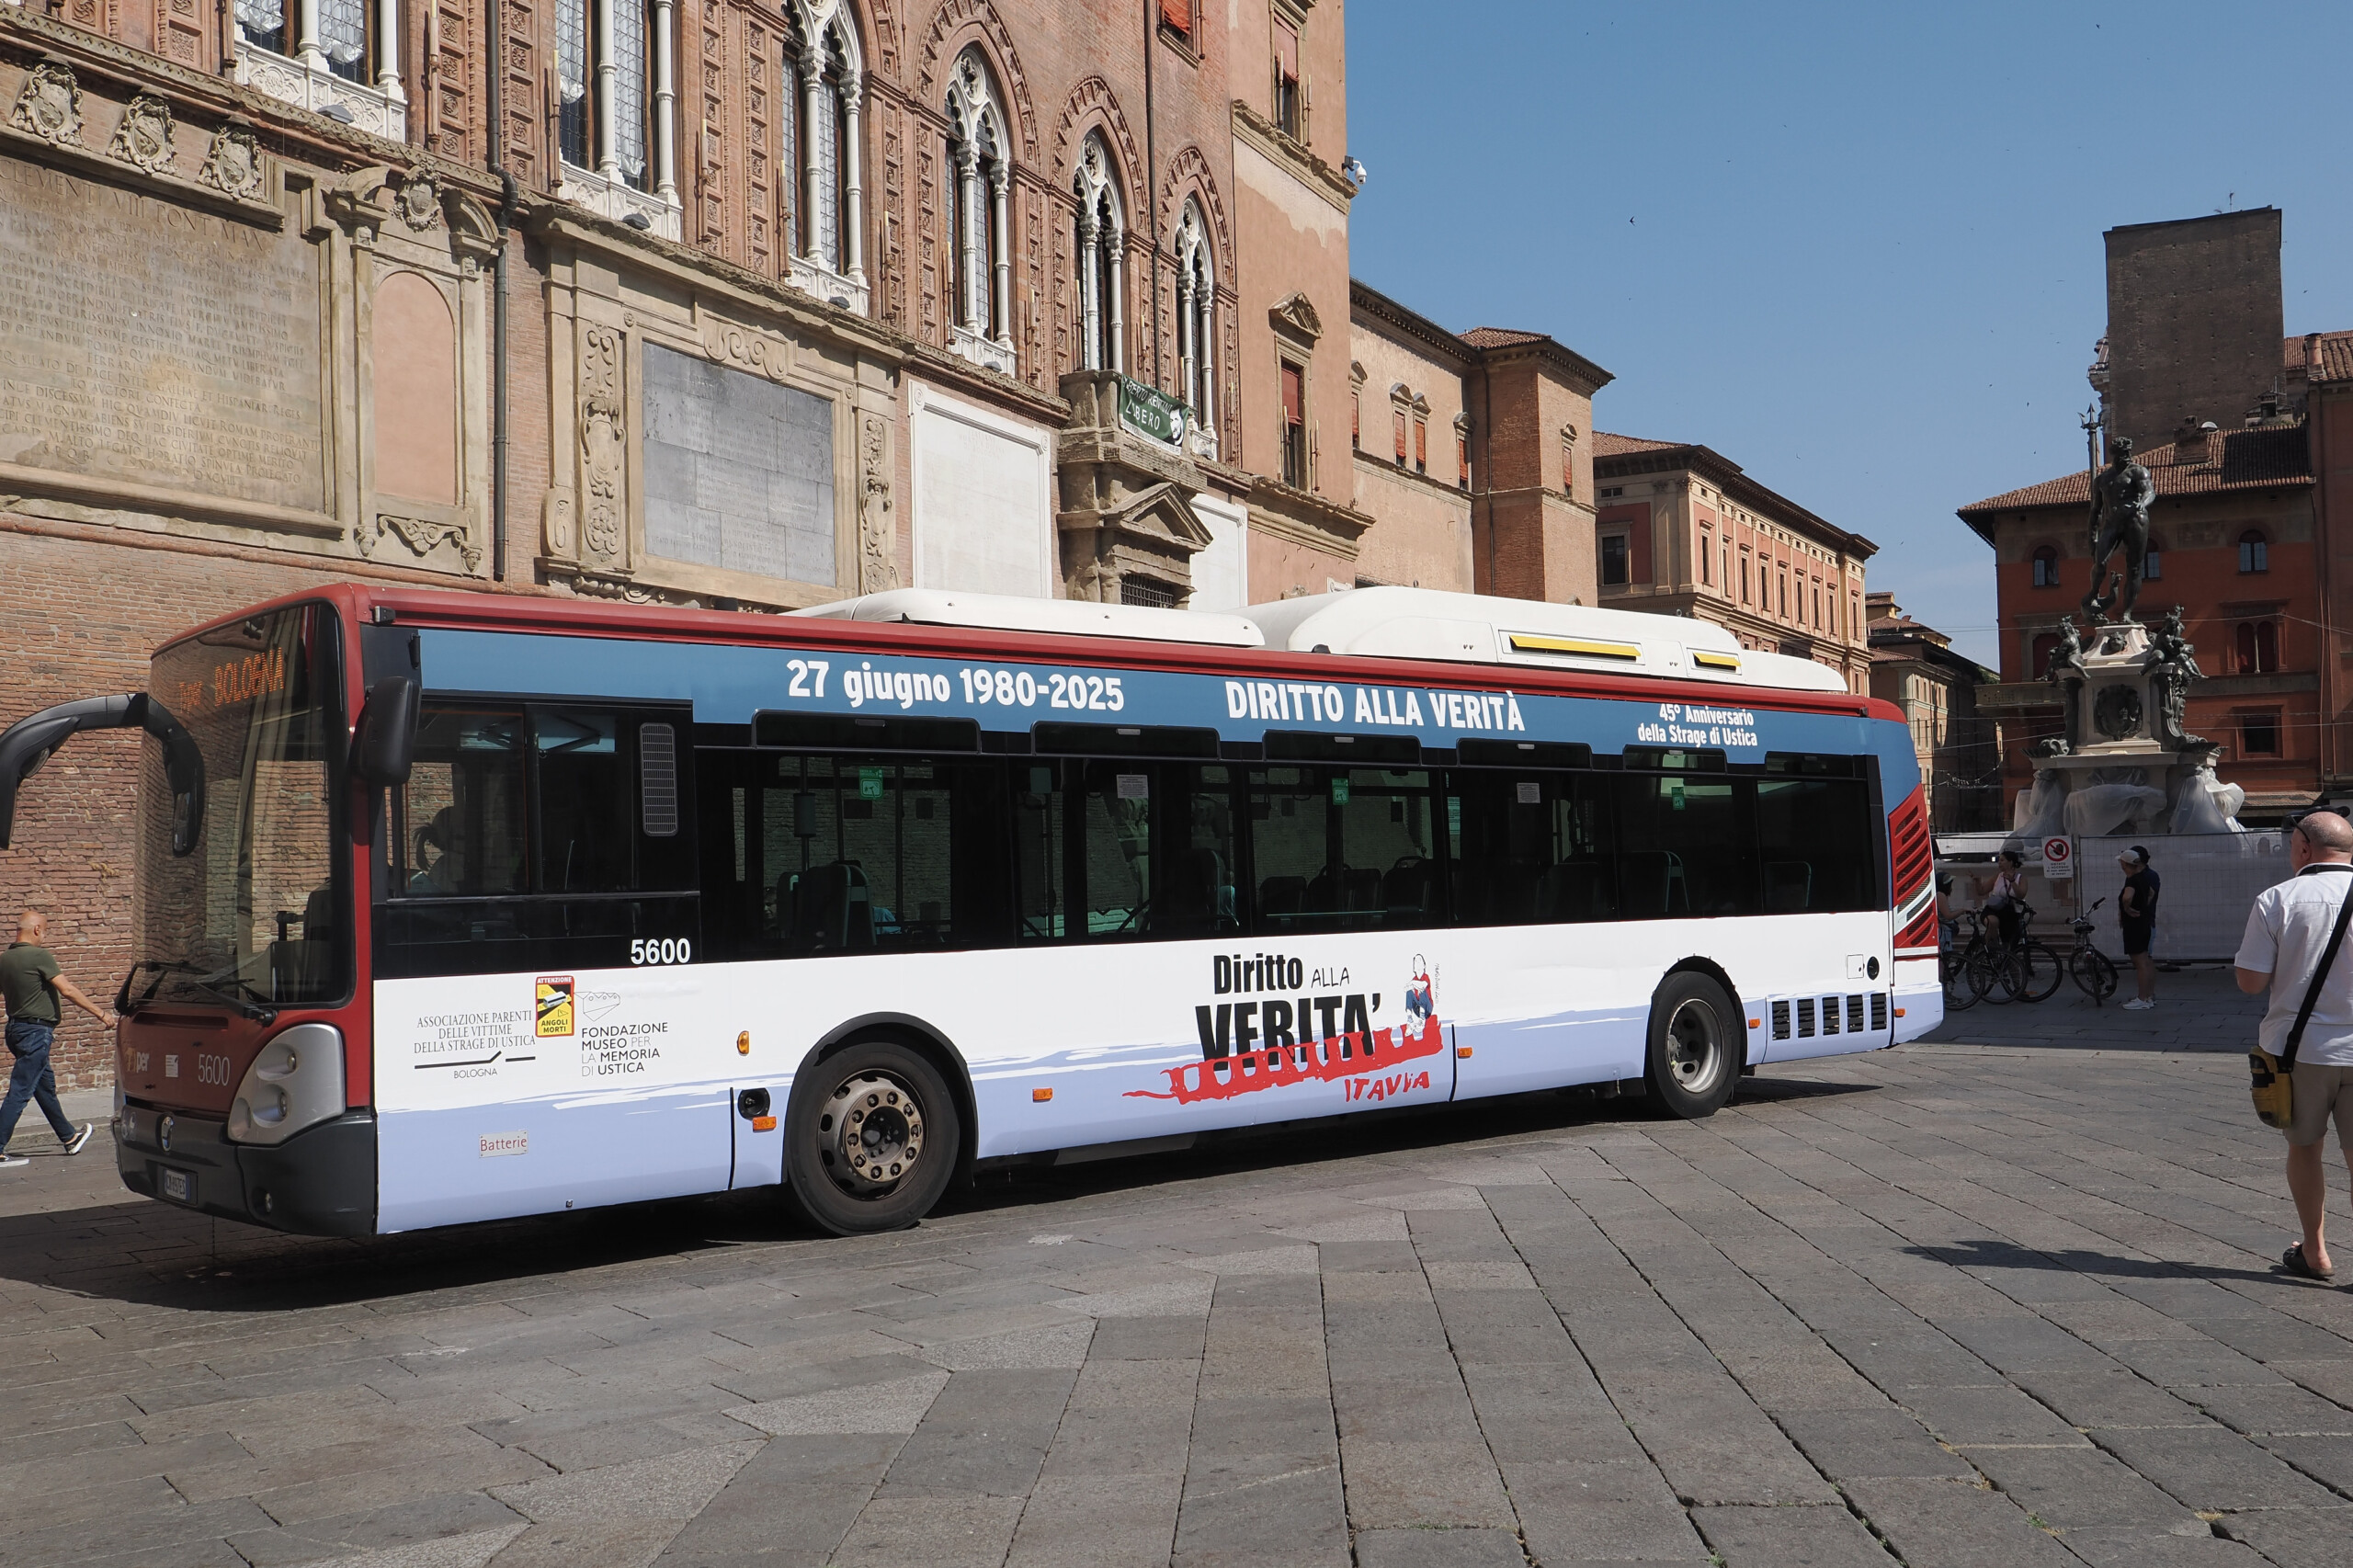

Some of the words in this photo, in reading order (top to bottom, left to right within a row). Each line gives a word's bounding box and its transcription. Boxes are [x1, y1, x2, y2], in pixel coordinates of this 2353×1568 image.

[0, 159, 102, 207] CLEMENTI
[113, 191, 145, 220] VIII
[79, 223, 129, 246] OPPRESSA
[225, 249, 235, 261] IN
[37, 284, 118, 314] ALDOBRANDINI
[246, 334, 257, 347] ET
[65, 318, 127, 344] FELICISSIME
[131, 335, 165, 352] GESTIS
[135, 322, 183, 341] INNOXIO
[87, 352, 153, 378] FERRARIAM
[130, 348, 161, 364] QVAM
[166, 355, 227, 379] SPERANDVM
[232, 370, 286, 392] VIDEBATVR
[67, 362, 79, 374] DE
[86, 366, 112, 381] PACE
[119, 372, 149, 389] INTER
[202, 391, 213, 403] ET
[146, 393, 202, 414] CONFECTA
[1125, 398, 1161, 431] LIBERO
[36, 385, 96, 409] DISCESSVM
[102, 398, 121, 413] HIC
[127, 403, 178, 423] QVAMDIV
[184, 415, 216, 430] LICVIT
[220, 420, 258, 438] ROMAM
[261, 428, 320, 451] PROPERANTI
[36, 400, 88, 421] MAGNVM
[95, 413, 130, 427] ABIENS
[133, 419, 150, 431] SVI
[153, 423, 213, 443] DESIDERIVM
[218, 434, 261, 451] CVNCTIS
[264, 443, 307, 460] RELIQVIT
[25, 414, 112, 437] CLEMENTISSIMO
[145, 433, 167, 448] HAC
[172, 438, 214, 457] CIVITATE
[218, 447, 255, 463] OPTIME
[258, 455, 295, 470] MERITO
[67, 435, 94, 449] ALTO
[99, 439, 142, 456] LEGATO
[201, 456, 242, 475] SPINVLA
[246, 464, 301, 485] PROLEGATO
[214, 646, 284, 708] BOLOGNA
[786, 659, 829, 698] 27
[843, 661, 951, 710] giugno
[959, 668, 1125, 711] 1980-2025
[1225, 680, 1345, 722] DIRITTO
[1355, 687, 1425, 726] ALLA
[1427, 689, 1526, 732] VERITÀ
[1685, 704, 1755, 726] Anniversario
[1637, 722, 1667, 743] della
[1668, 724, 1708, 748] Strage
[1709, 726, 1721, 745] di
[1722, 727, 1758, 747] Ustica
[630, 937, 691, 965] 5600
[537, 976, 574, 984] ATTENZIONE
[1213, 951, 1303, 995] Diritto
[1310, 967, 1351, 989] ALLA
[416, 1012, 490, 1028] ASSOCIAZIONE
[491, 1009, 533, 1024] PARENTI
[438, 1026, 470, 1040] DELLE
[471, 1023, 513, 1038] VITTIME
[540, 1018, 568, 1028] ANGOLI
[542, 1025, 567, 1034] MORTI
[581, 1021, 669, 1039] FONDAZIONE
[414, 1040, 446, 1054] DELLA
[447, 1037, 486, 1052] STRAGE
[487, 1037, 499, 1050] DI
[501, 1034, 537, 1048] USTICA
[581, 1038, 628, 1051] MUSEO
[630, 1035, 652, 1049] PER
[581, 1052, 597, 1064] LA
[600, 1048, 661, 1062] MEMORIA
[198, 1053, 231, 1086] 5600
[453, 1067, 498, 1079] BOLOGNA
[581, 1065, 595, 1077] DI
[597, 1062, 645, 1075] USTICA
[479, 1137, 528, 1153] Batterie
